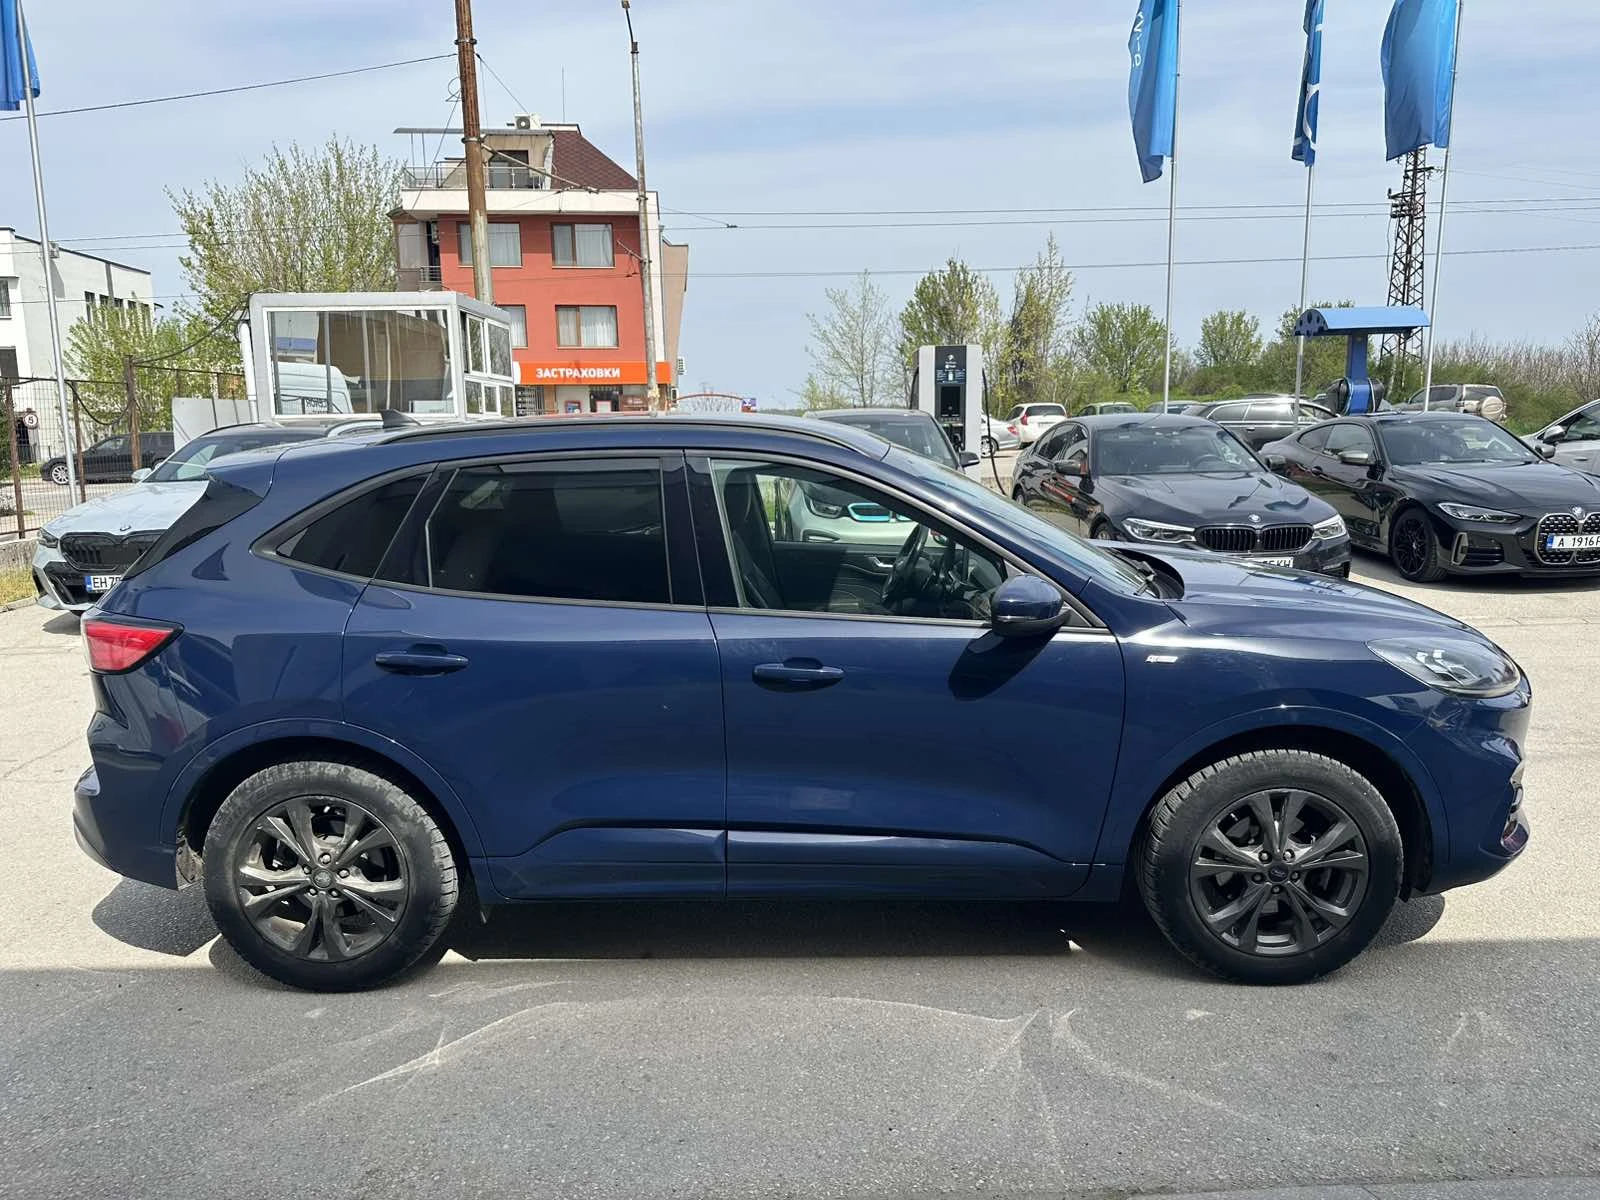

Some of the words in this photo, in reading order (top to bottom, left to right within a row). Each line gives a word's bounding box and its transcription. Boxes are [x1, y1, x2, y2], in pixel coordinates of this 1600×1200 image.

[536, 367, 620, 379] ЗАСТРАХОВКИ
[1558, 537, 1565, 547] A
[92, 577, 107, 588] EH
